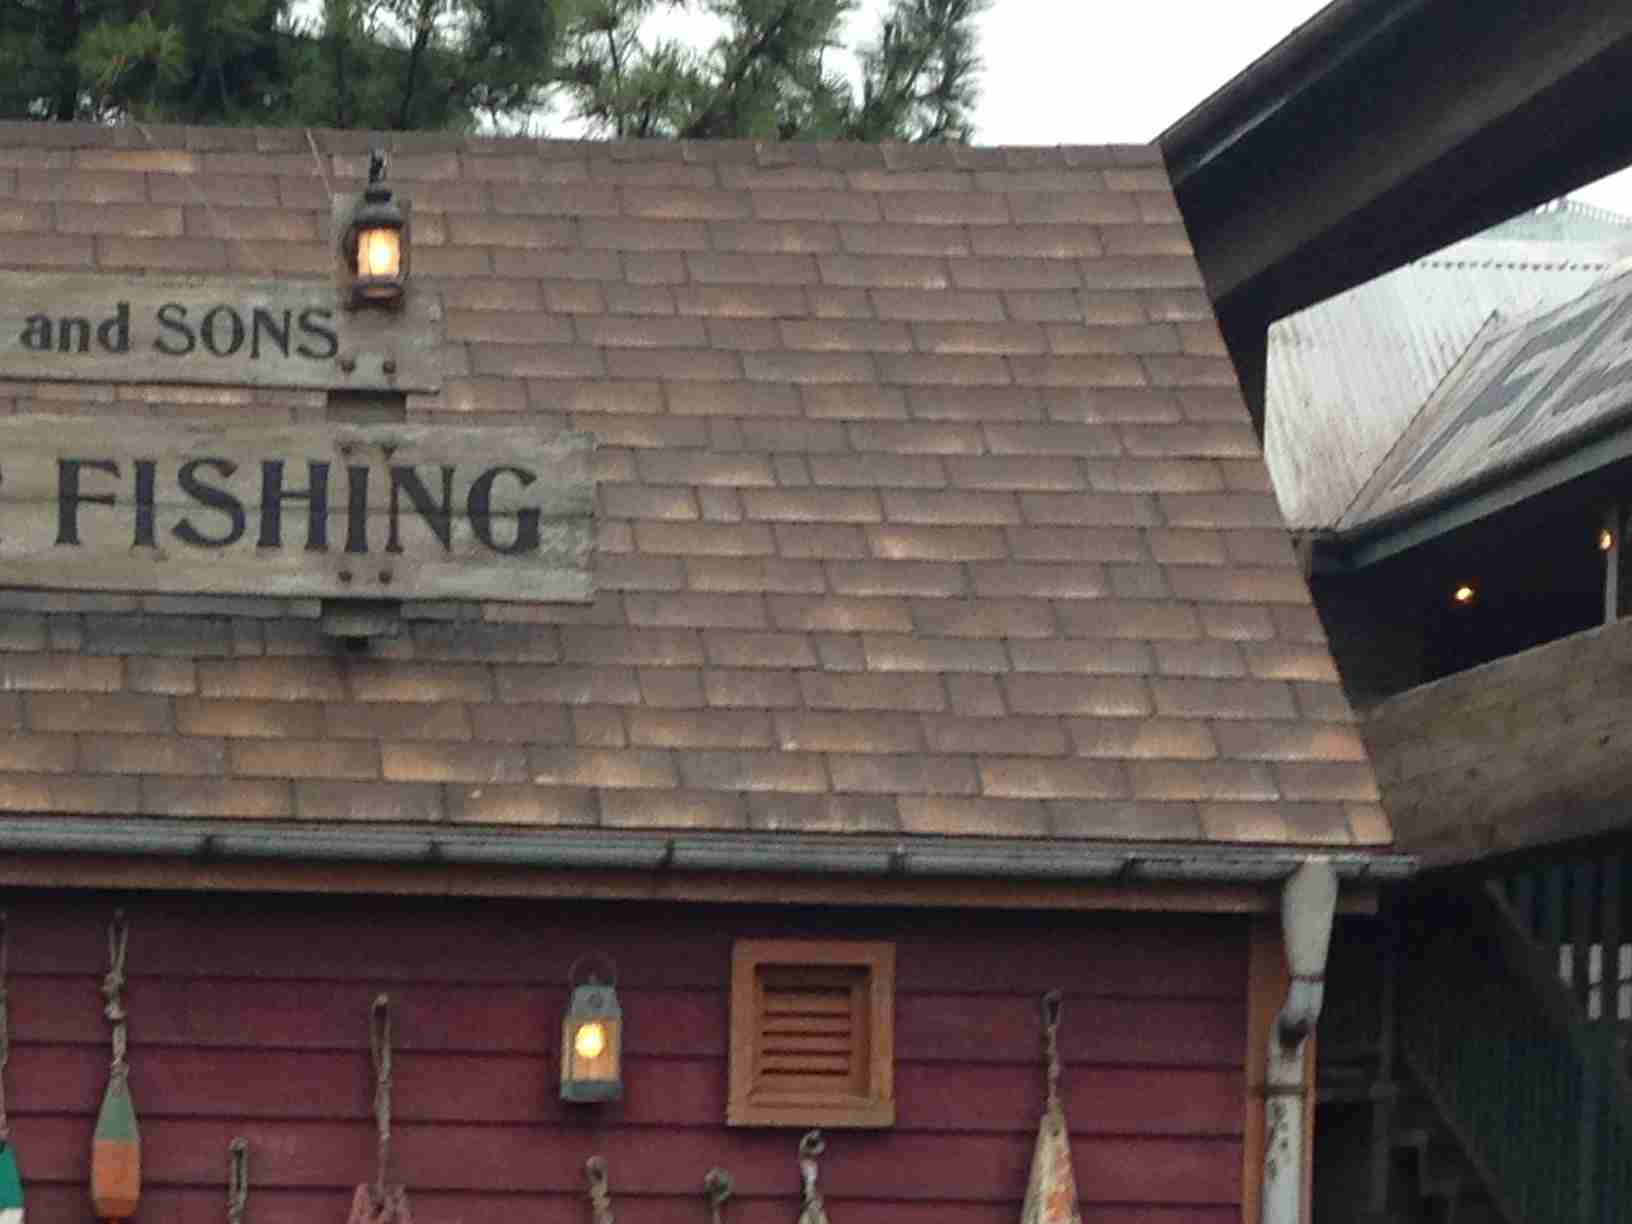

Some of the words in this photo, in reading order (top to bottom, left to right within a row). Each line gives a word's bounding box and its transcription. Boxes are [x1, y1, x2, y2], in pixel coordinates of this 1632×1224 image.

[20, 301, 130, 353] and
[154, 302, 339, 359] SONS
[55, 456, 542, 556] FISHING
